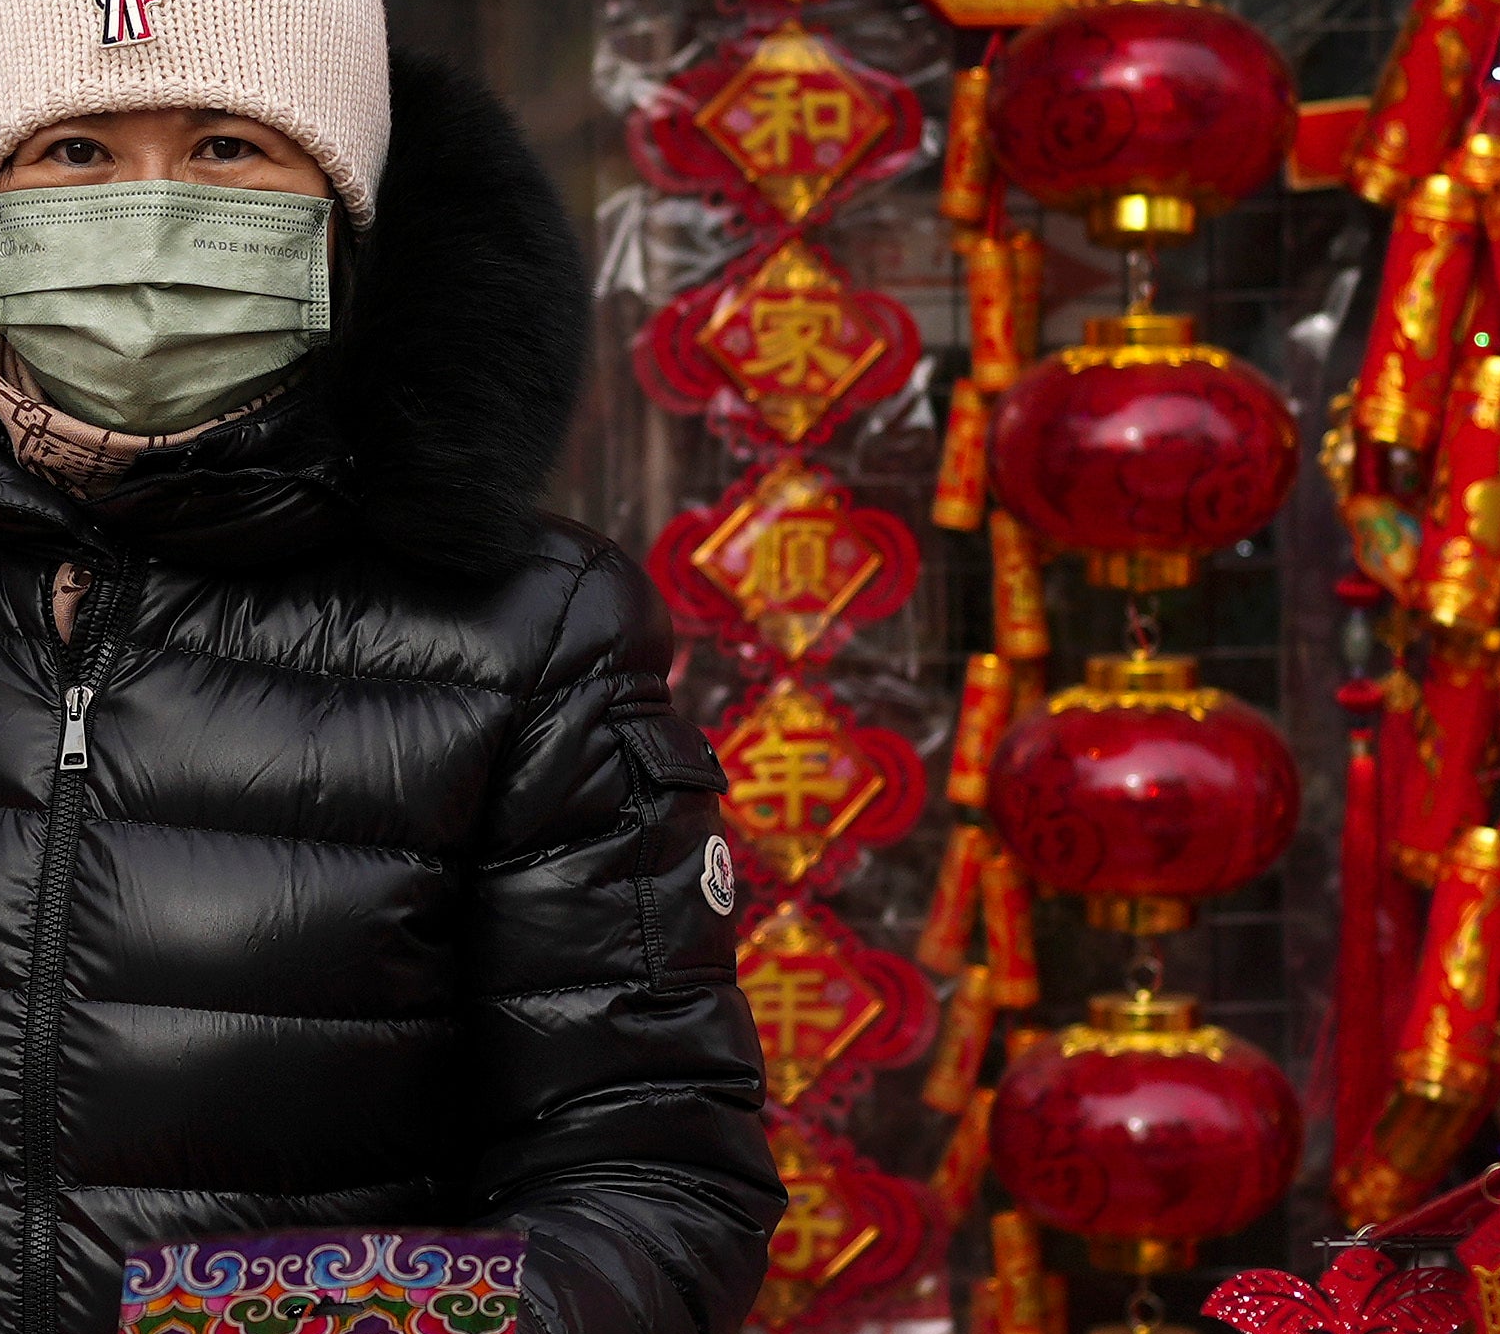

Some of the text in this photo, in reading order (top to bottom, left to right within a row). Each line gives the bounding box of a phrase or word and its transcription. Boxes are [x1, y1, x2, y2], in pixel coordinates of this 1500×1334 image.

[193, 238, 309, 261] MADE IN MACAU
